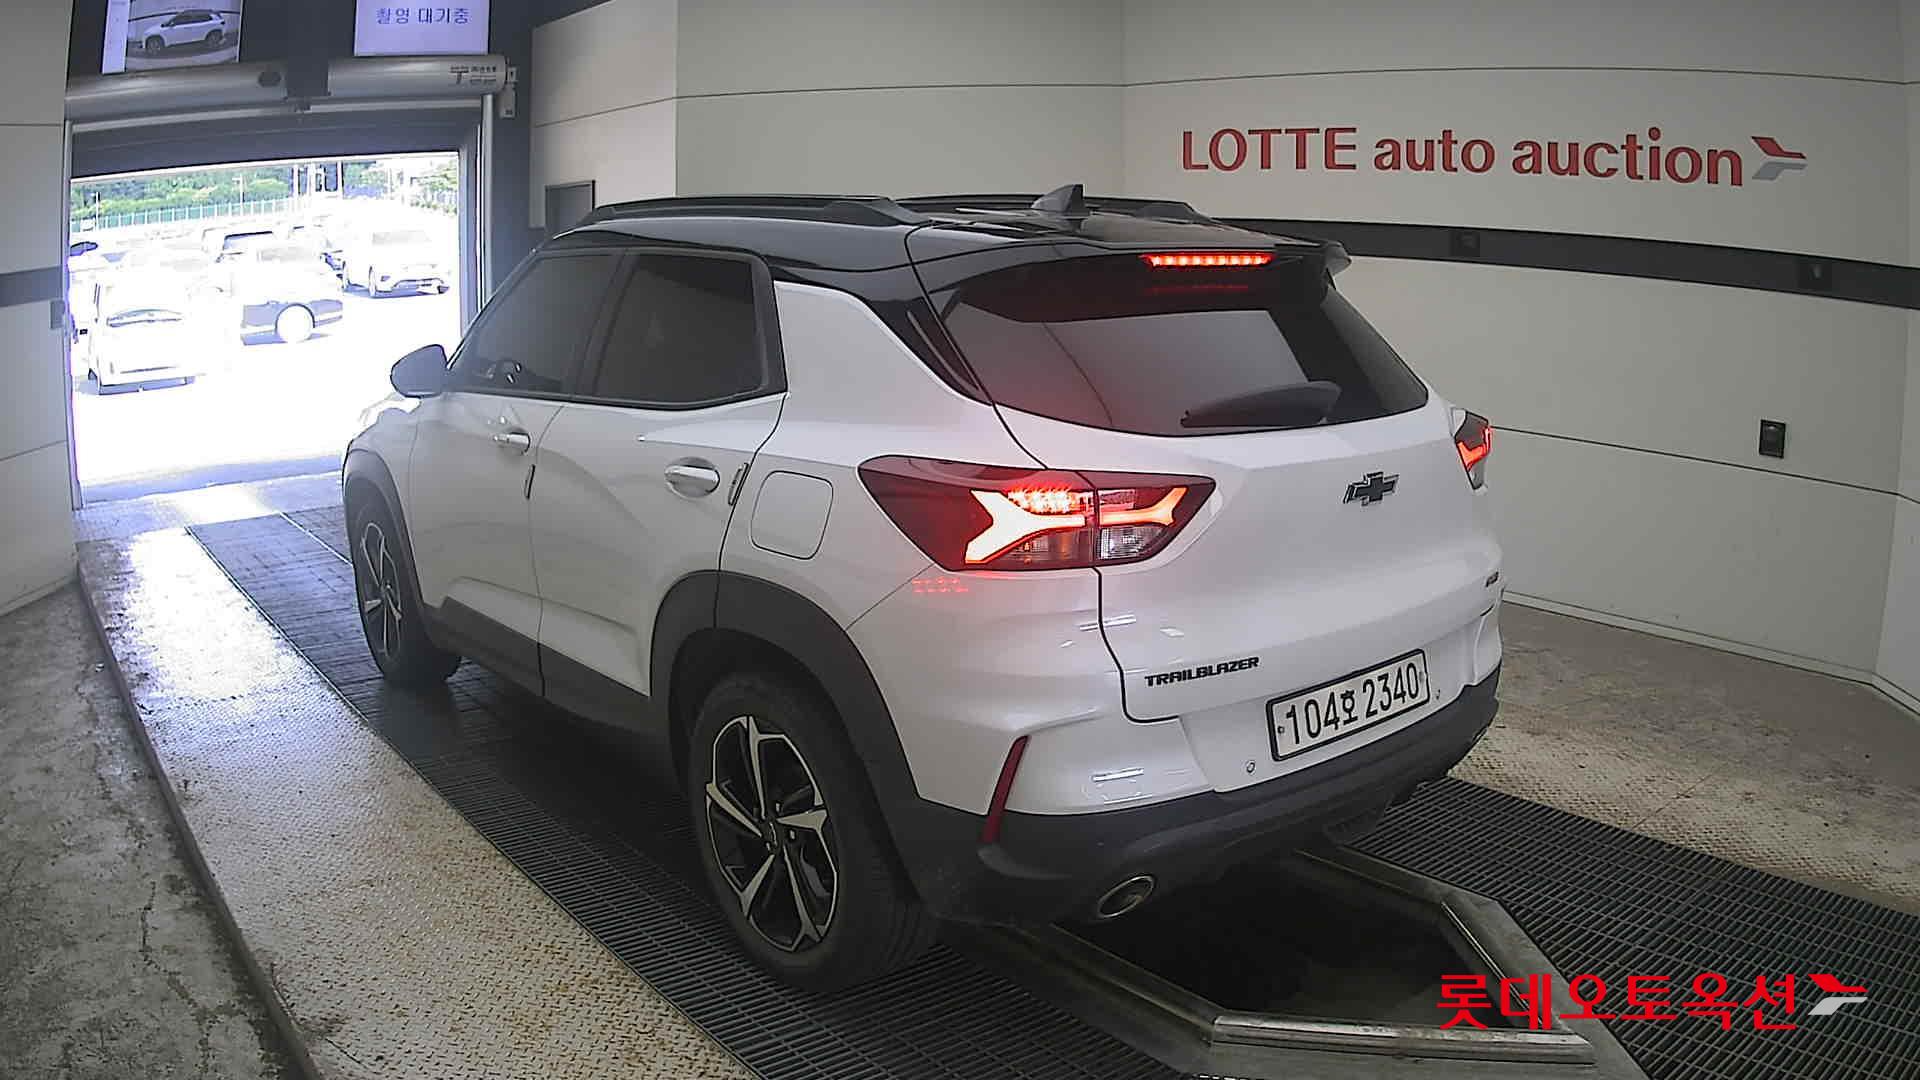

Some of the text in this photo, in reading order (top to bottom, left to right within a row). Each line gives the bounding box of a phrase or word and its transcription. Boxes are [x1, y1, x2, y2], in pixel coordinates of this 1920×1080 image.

[376, 7, 470, 25] 촬영 대기중
[1182, 127, 1743, 186] LOTTE auto auction
[1144, 656, 1260, 687] TRAILBLAZER
